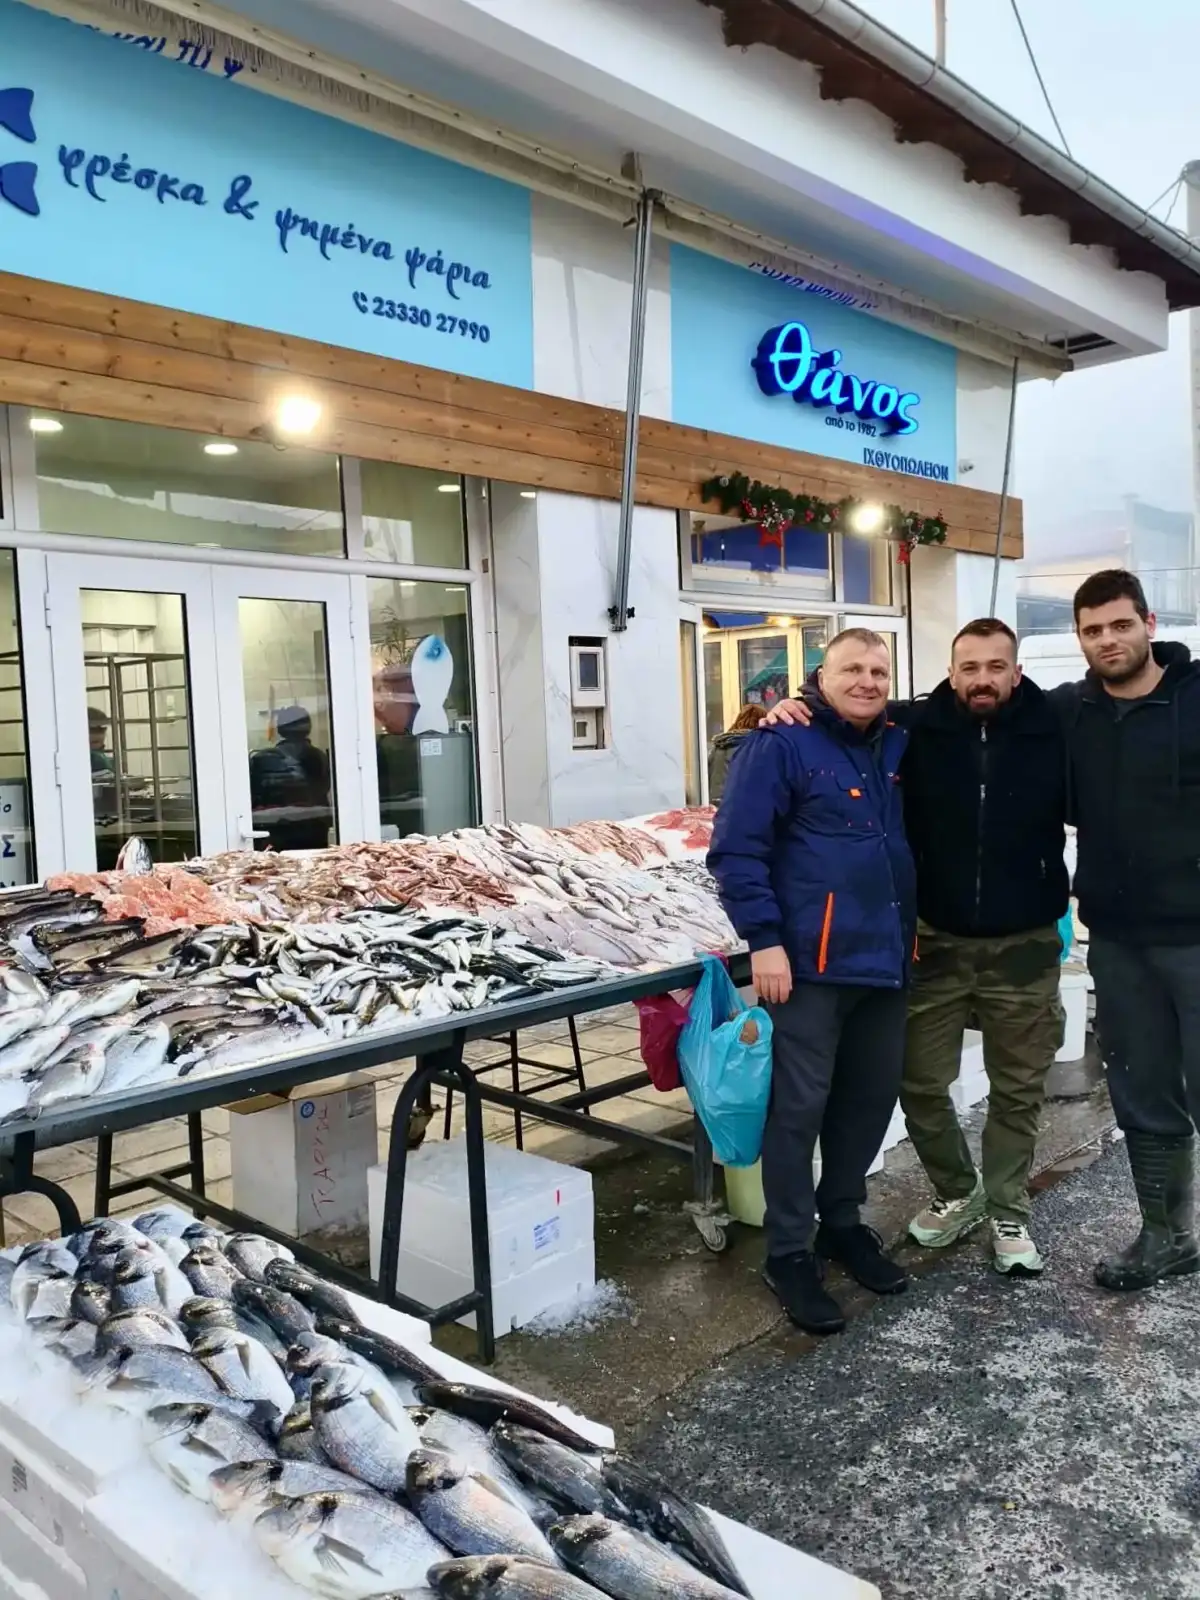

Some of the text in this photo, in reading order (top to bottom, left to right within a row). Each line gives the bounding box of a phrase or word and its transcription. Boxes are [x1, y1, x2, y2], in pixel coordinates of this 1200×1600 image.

[58, 144, 492, 299] φρέσκα & ψημένα ψάρια
[372, 296, 491, 343] 23330 27990
[825, 416, 877, 437] από το 1982
[863, 447, 949, 480] ΙΧΘΥΟΠΩΛΕΙΟΝ
